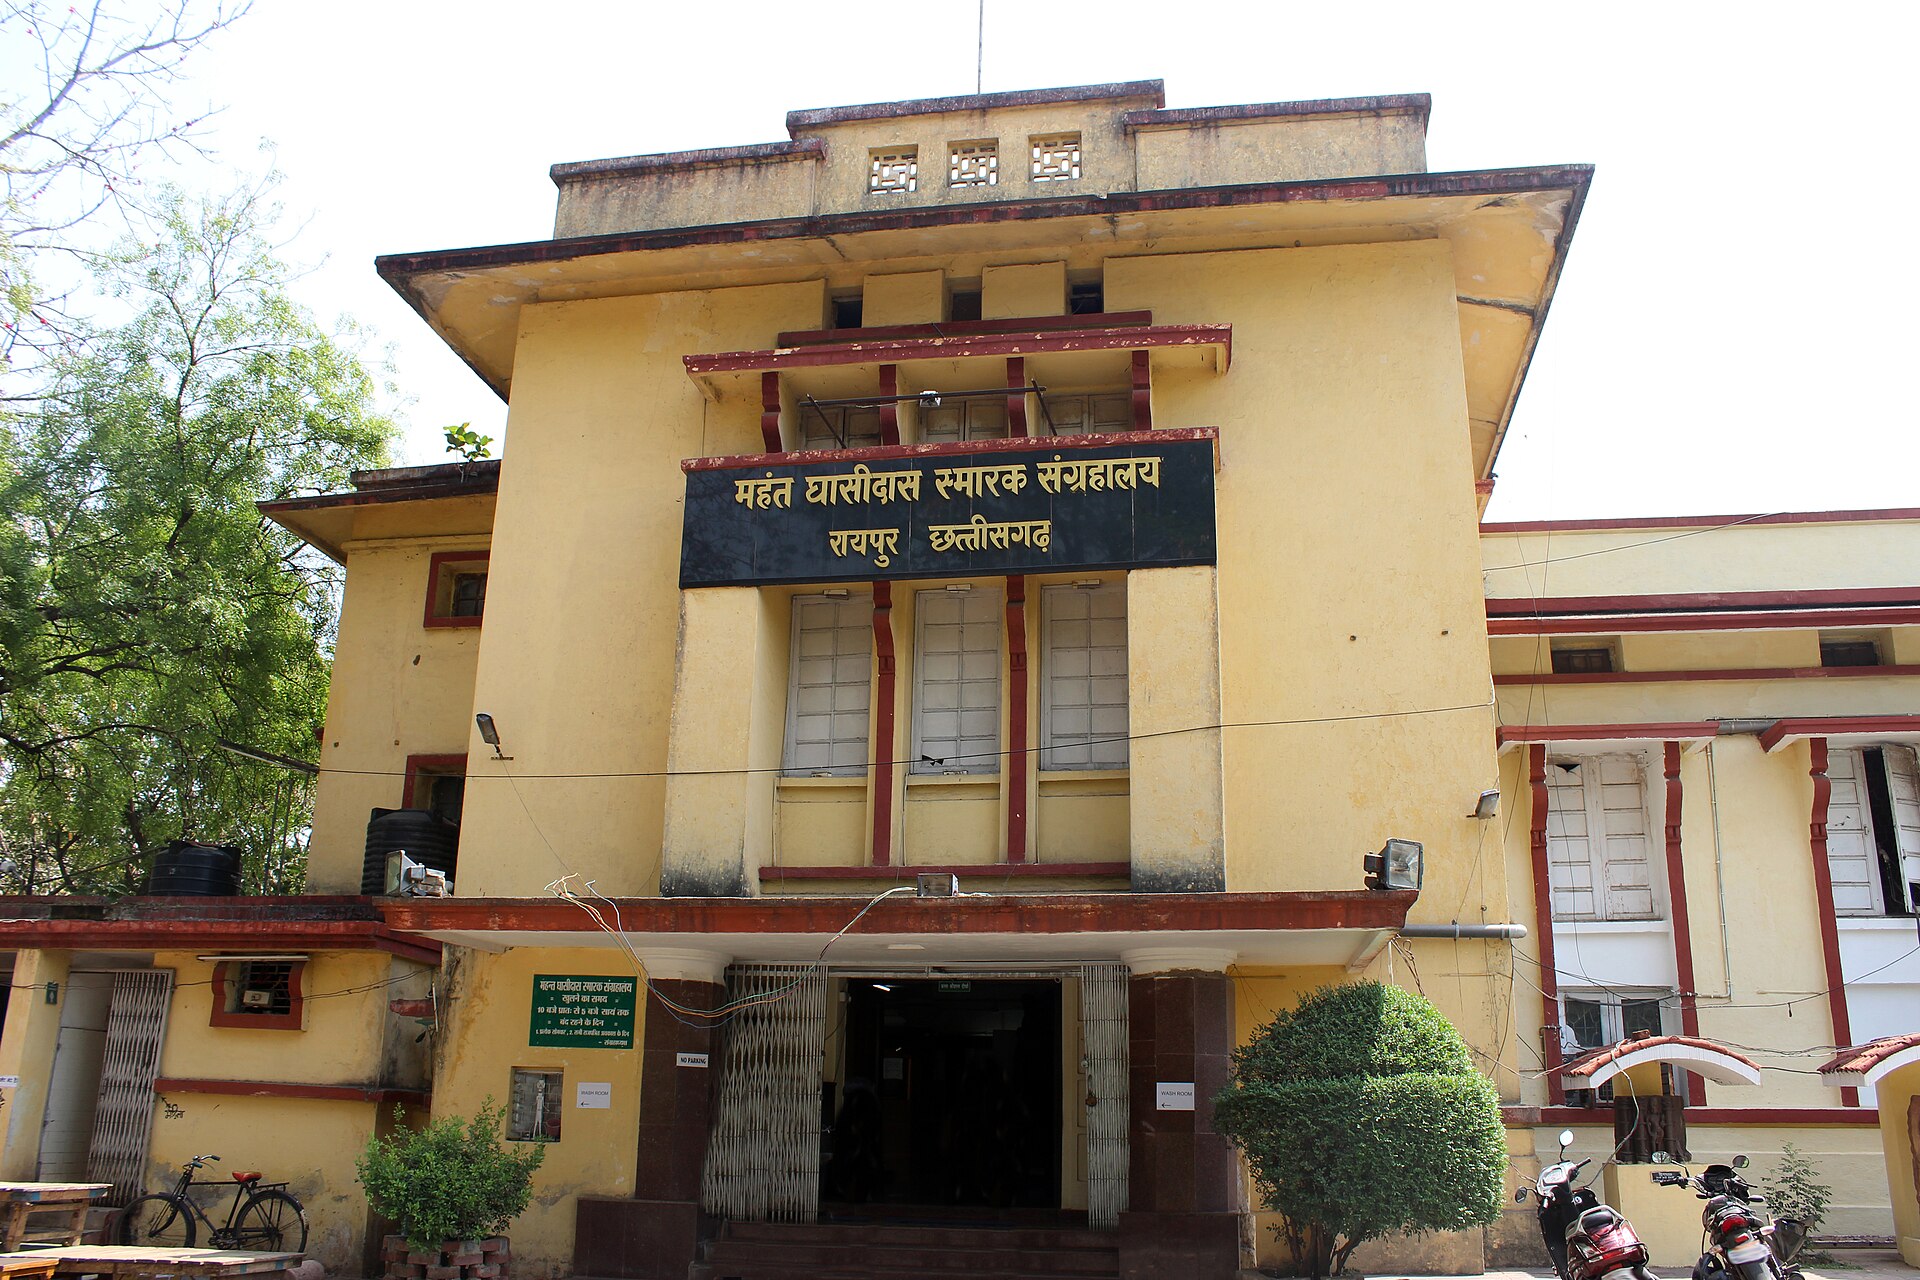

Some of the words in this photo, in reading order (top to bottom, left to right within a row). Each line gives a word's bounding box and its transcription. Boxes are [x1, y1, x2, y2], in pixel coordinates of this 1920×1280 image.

[734, 470, 796, 510] महंत
[805, 463, 923, 506] घासीदास
[933, 463, 1027, 501] स्मारक
[1036, 454, 1163, 495] संग्रहालय
[828, 527, 900, 568] रायपुर
[928, 512, 1053, 554] छत्तीसगढ़
[562, 993, 580, 1004] खुलने
[580, 994, 591, 1003] का
[545, 1004, 557, 1014] बजे
[587, 1006, 599, 1015] बजे
[687, 1057, 707, 1065] PARKING
